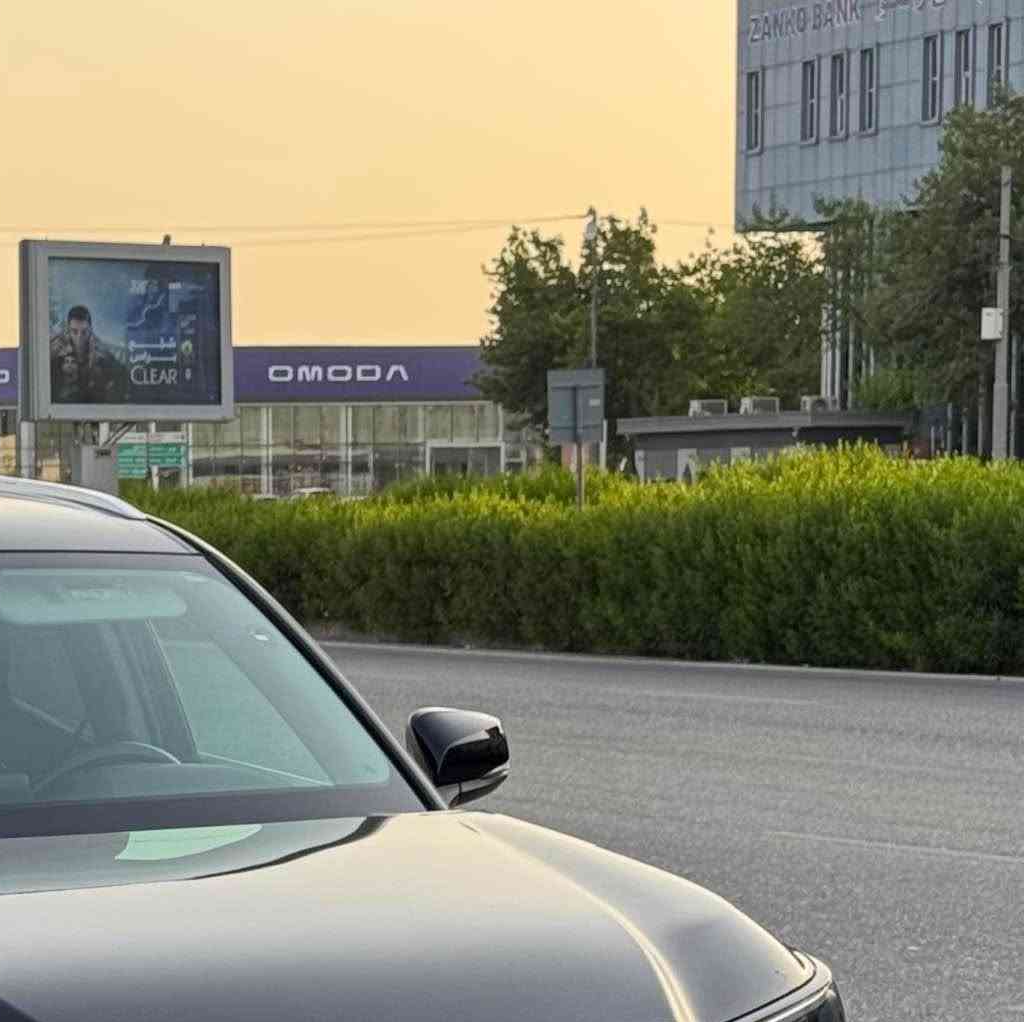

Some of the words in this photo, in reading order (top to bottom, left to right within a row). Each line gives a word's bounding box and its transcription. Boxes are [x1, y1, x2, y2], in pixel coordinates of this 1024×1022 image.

[749, 7, 807, 42] ZANKO
[812, 0, 861, 31] BANK
[130, 365, 178, 385] CLEAR
[268, 364, 409, 382] OMODA
